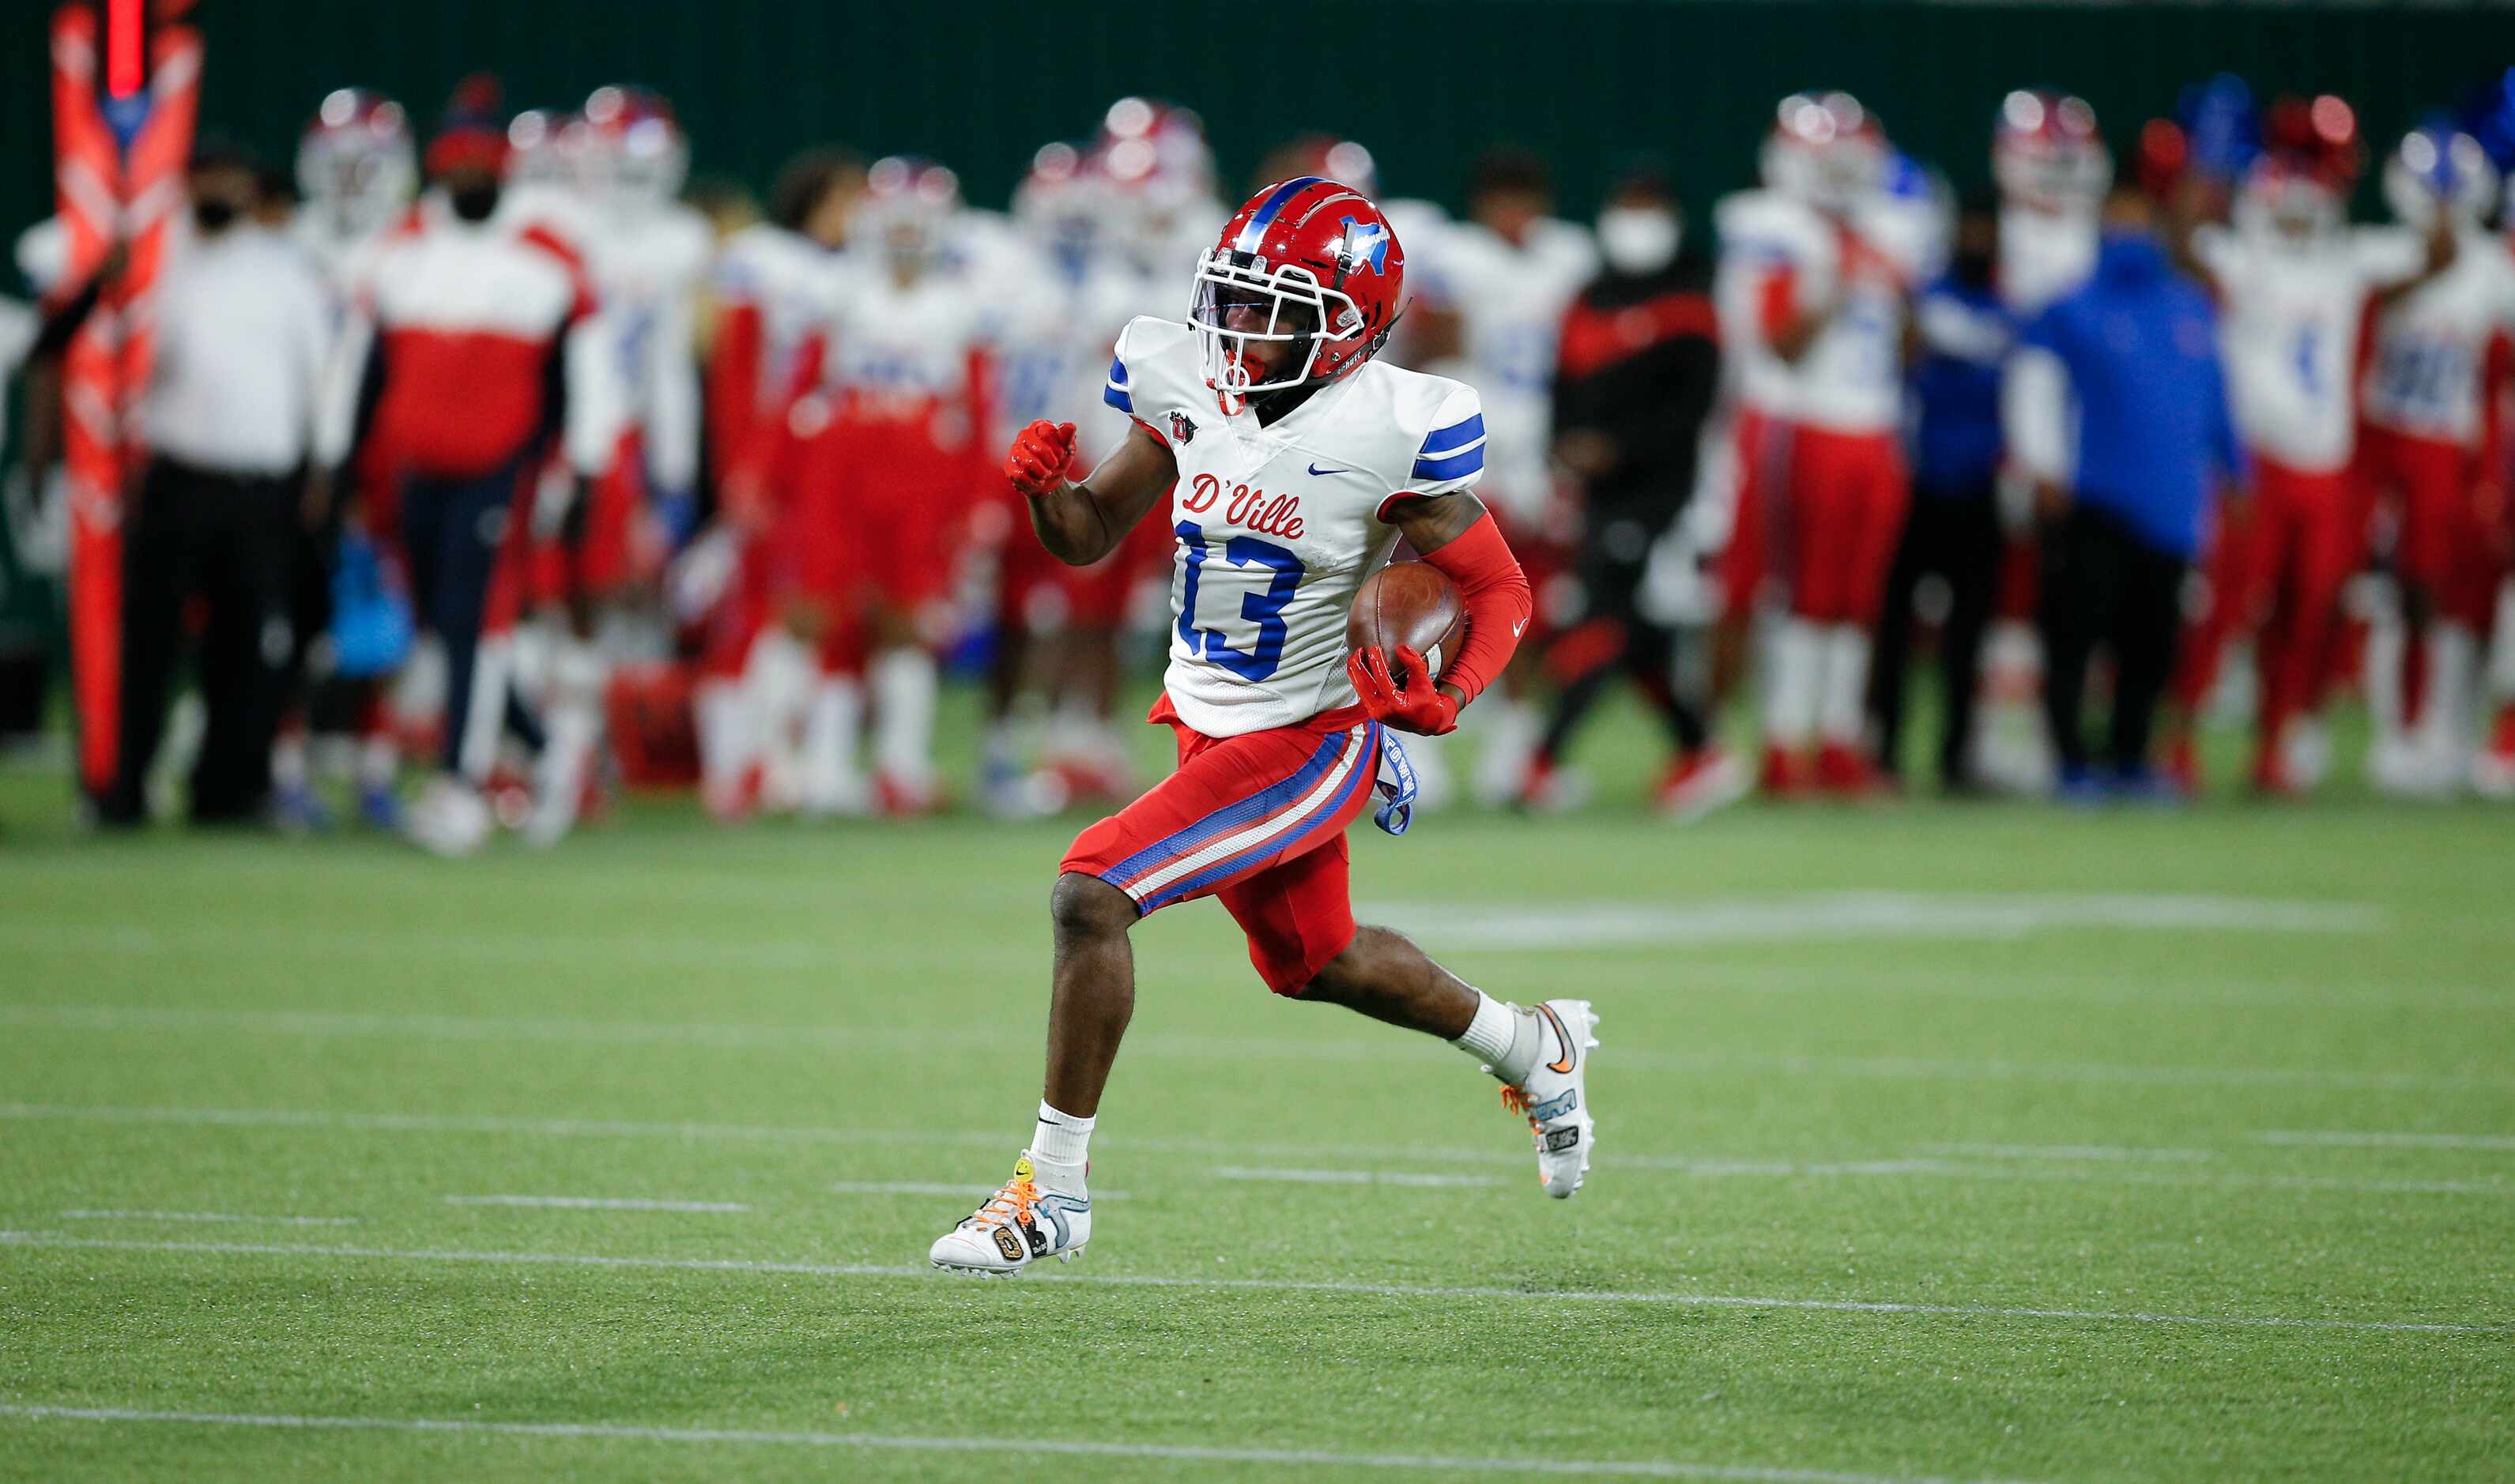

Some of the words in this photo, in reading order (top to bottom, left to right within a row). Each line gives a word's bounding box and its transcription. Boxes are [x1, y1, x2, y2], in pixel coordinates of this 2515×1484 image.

[1182, 473, 1304, 540] D'Ville
[1175, 519, 1306, 683] 13
[1383, 733, 1415, 797] TOWN
